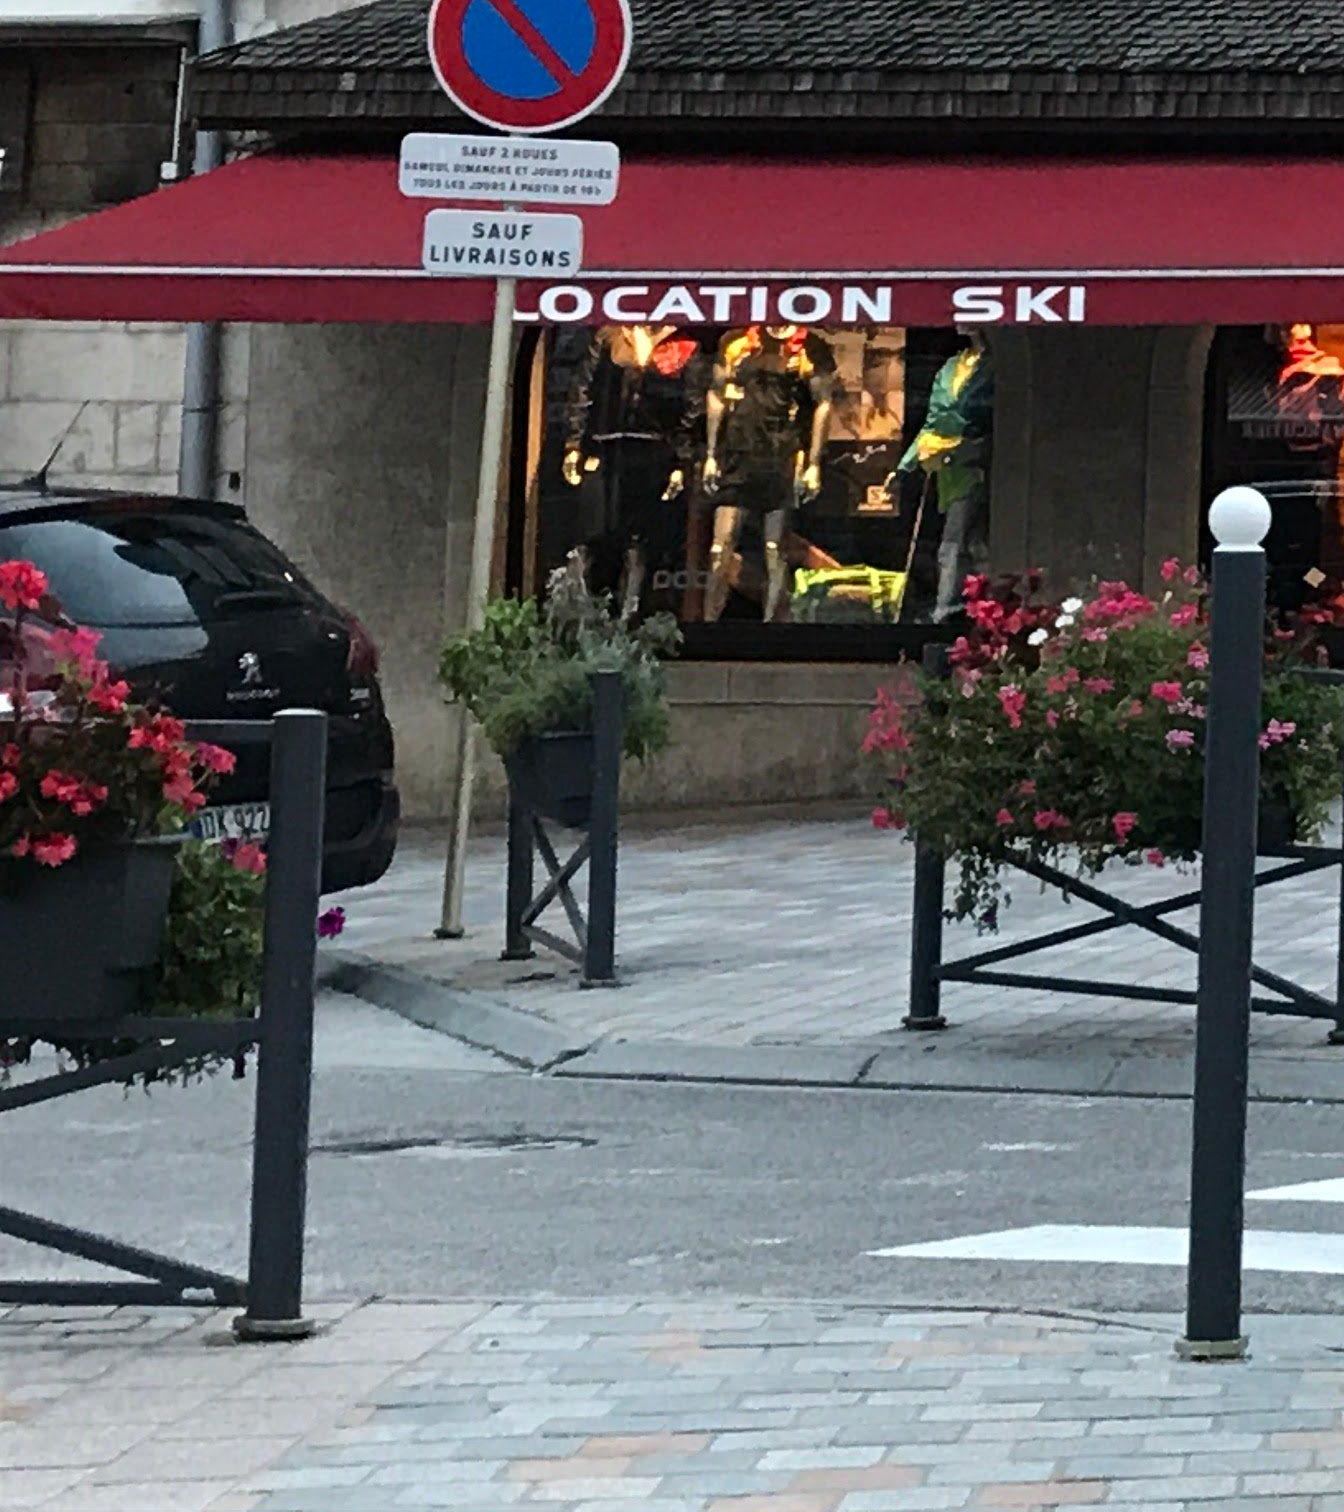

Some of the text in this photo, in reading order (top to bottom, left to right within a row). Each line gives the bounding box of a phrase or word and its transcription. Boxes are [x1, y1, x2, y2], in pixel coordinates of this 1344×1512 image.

[461, 145, 496, 158] SAUF
[501, 147, 509, 158] 2
[472, 222, 533, 241] SAUF
[430, 245, 571, 268] LIVRAISONS
[952, 285, 1087, 323] SKI
